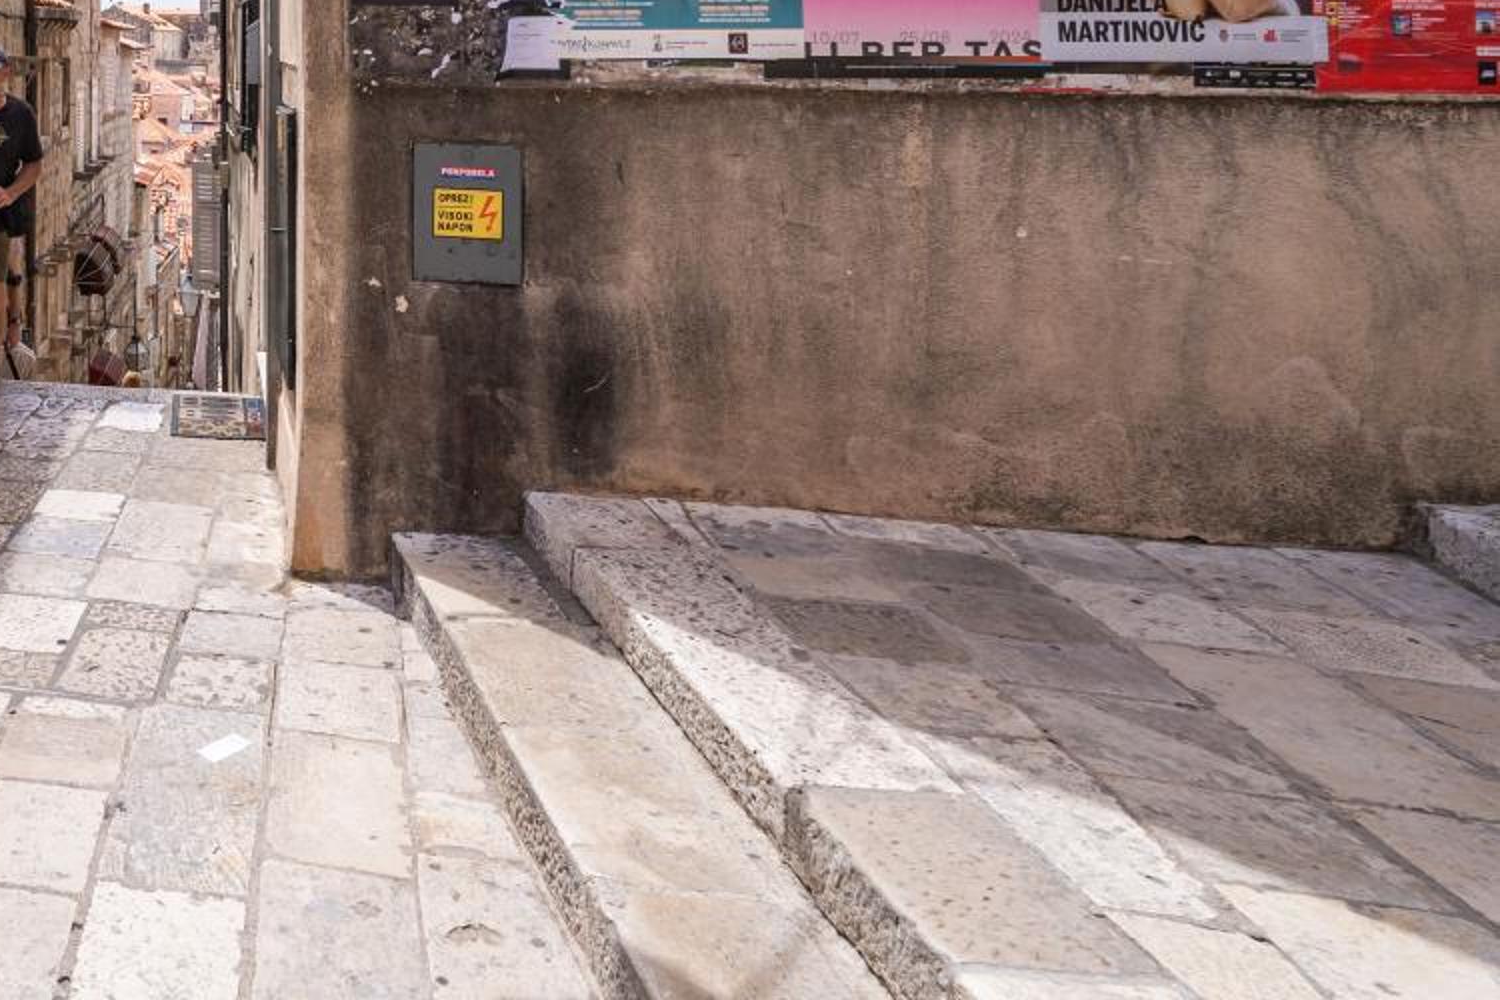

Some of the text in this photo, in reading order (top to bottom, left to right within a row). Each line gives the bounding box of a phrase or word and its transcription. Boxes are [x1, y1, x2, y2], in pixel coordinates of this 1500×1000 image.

[1058, 20, 1205, 44] MARTINOVIĆ
[438, 211, 474, 221] VISOKI
[438, 222, 474, 233] NAPON
